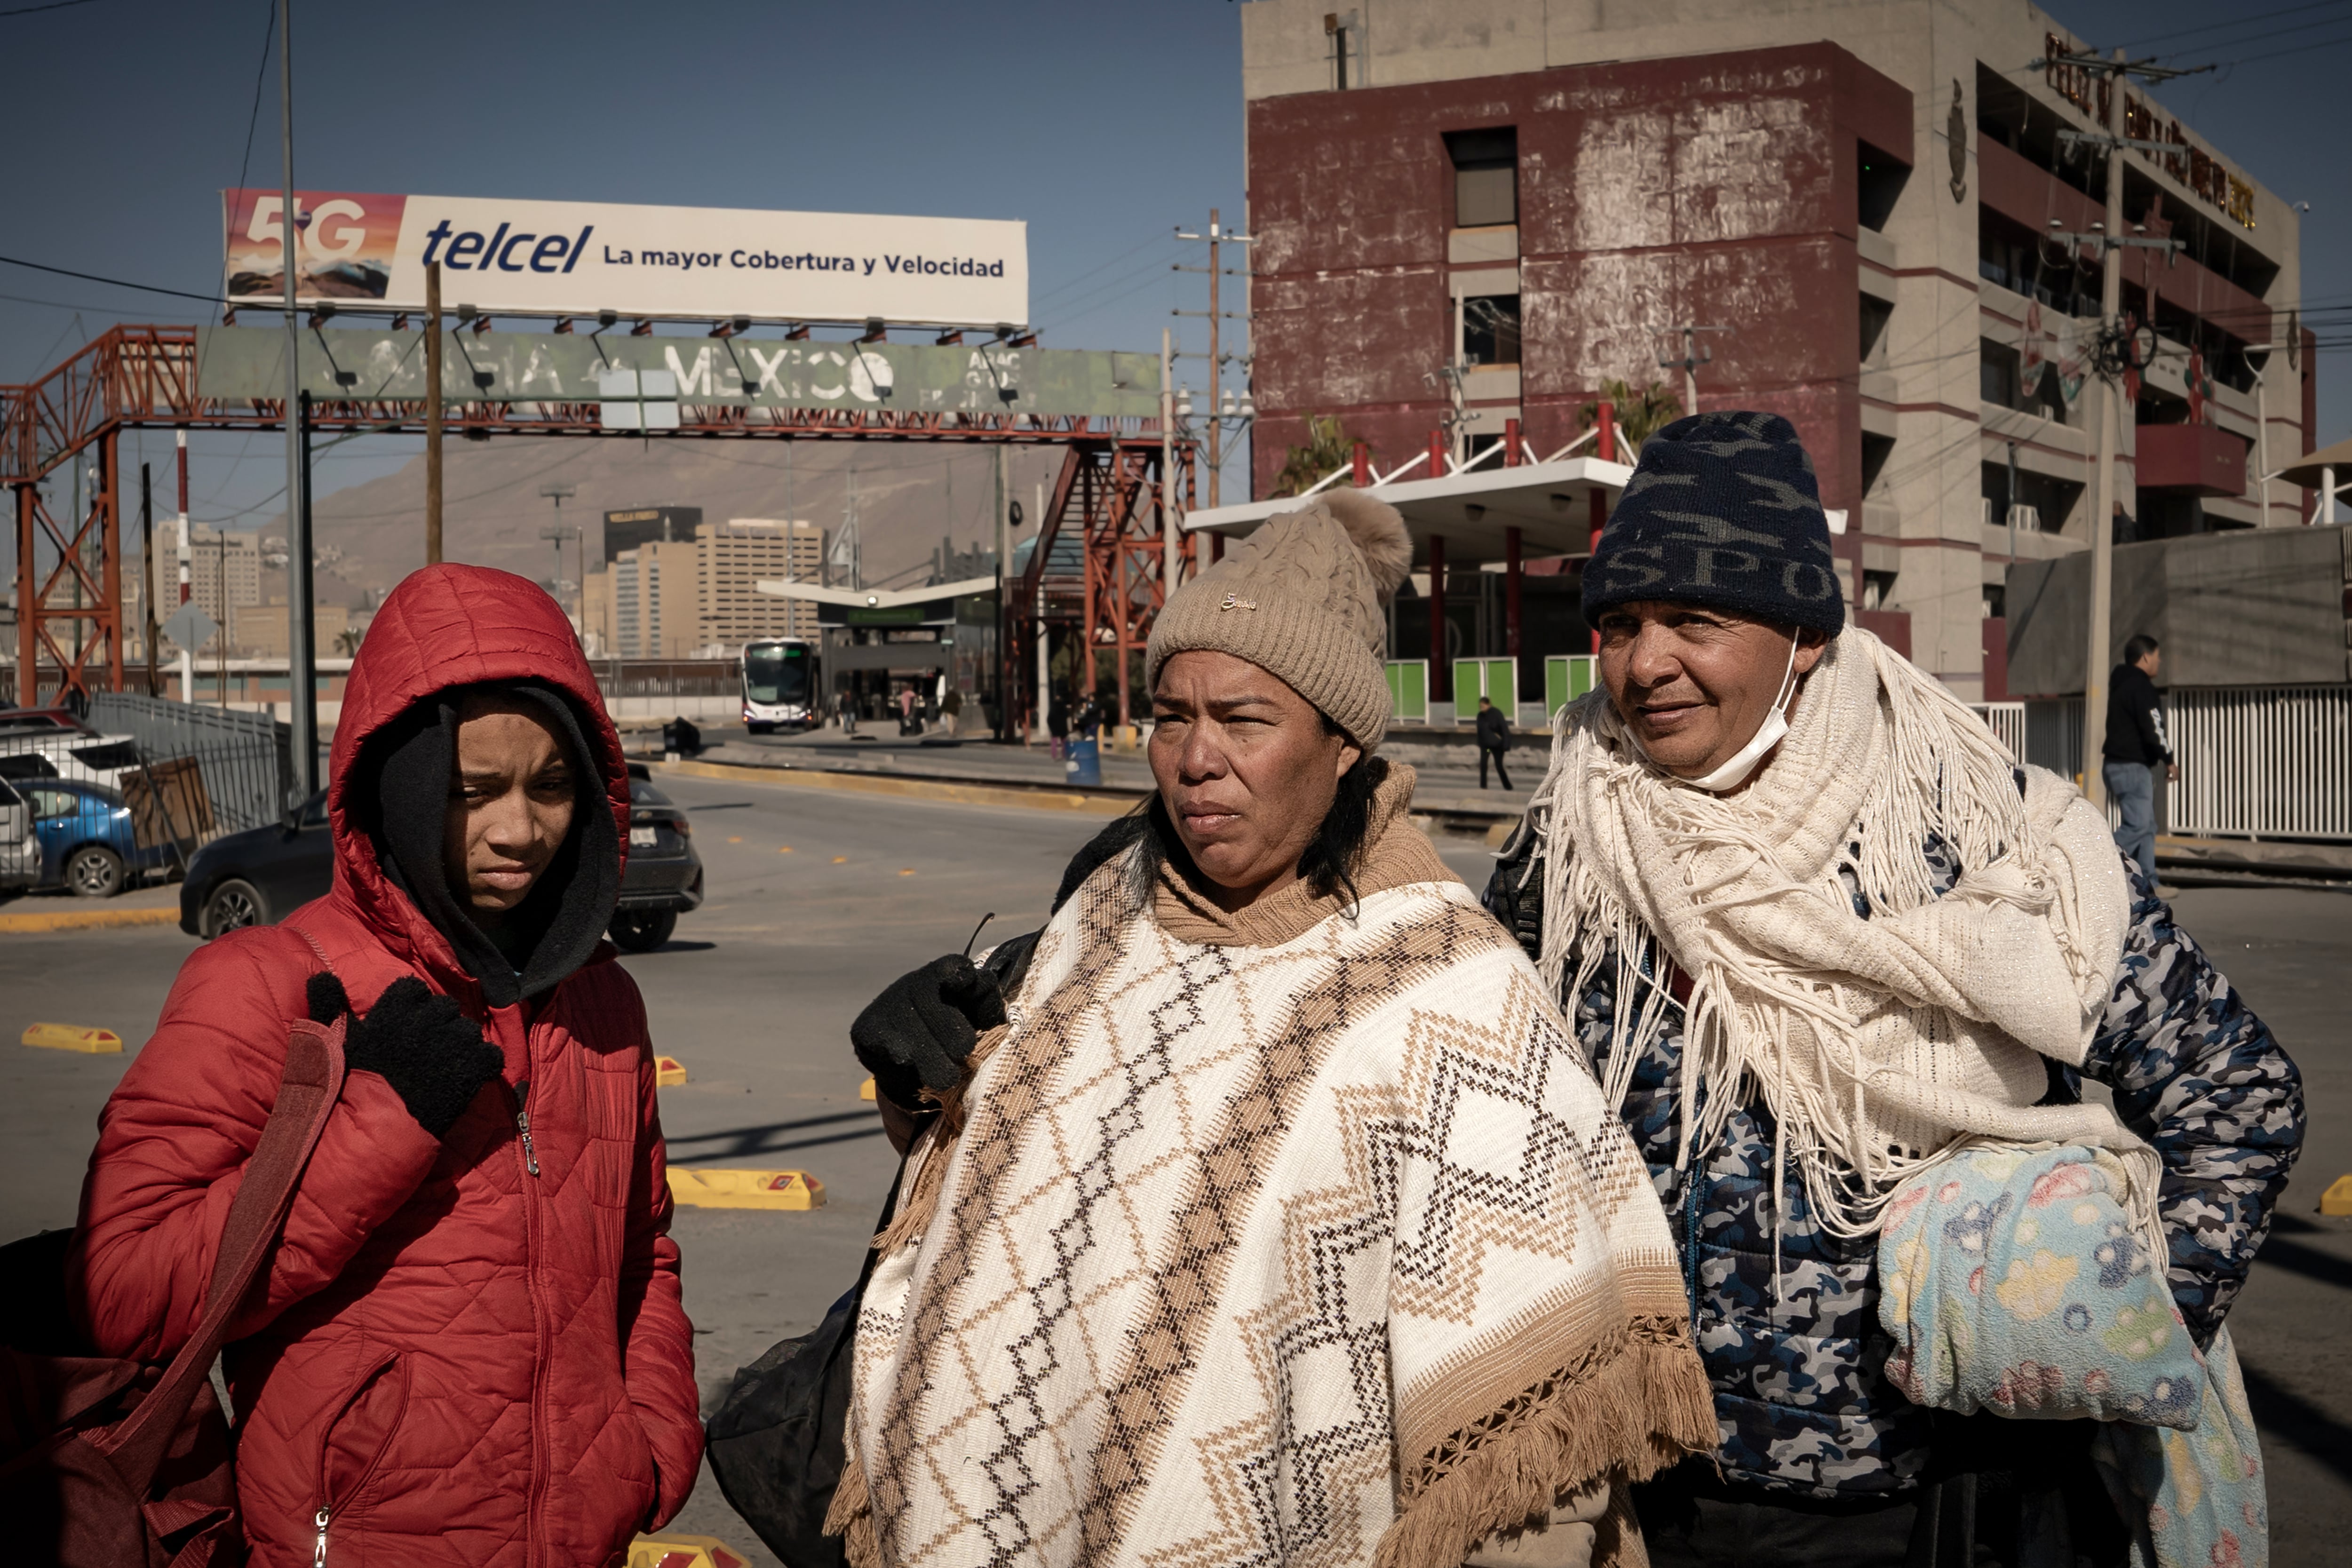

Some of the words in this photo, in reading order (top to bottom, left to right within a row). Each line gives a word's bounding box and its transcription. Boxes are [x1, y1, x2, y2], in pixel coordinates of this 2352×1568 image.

[242, 196, 366, 268] 5G
[422, 220, 594, 273] telcel
[604, 246, 633, 264] La
[642, 251, 722, 271] mayor
[730, 249, 855, 271] Cobertura
[864, 259, 875, 276] y
[885, 255, 1003, 277] Velocidad
